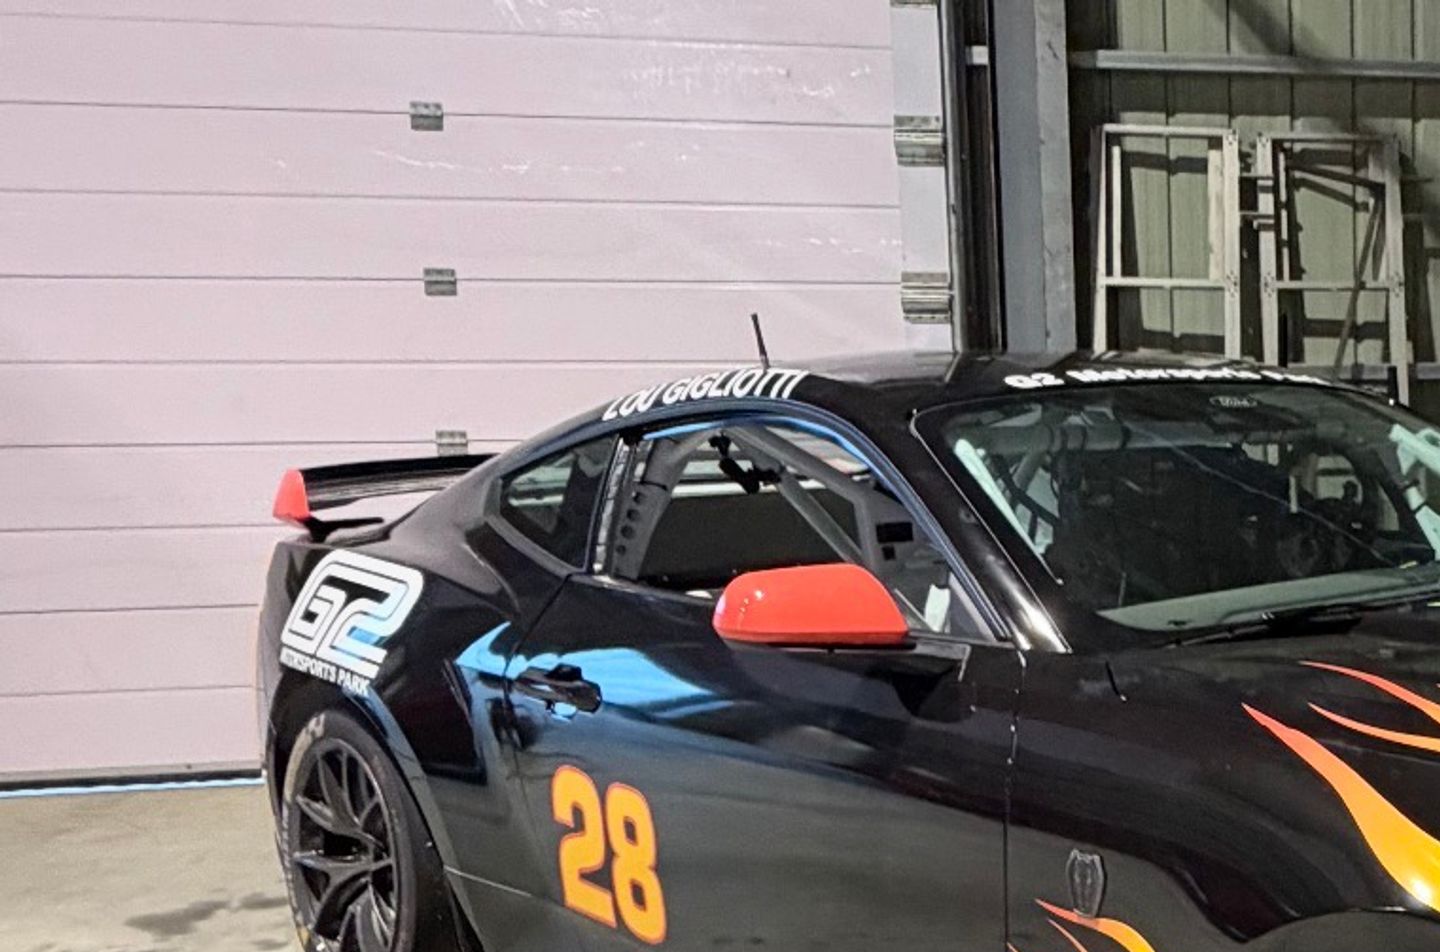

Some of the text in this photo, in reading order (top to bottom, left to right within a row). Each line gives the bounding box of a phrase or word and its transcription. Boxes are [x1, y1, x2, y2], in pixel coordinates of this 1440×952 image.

[601, 367, 810, 421] LOU GIGLIOTTI
[337, 668, 371, 698] PARK
[551, 764, 668, 944] 28
